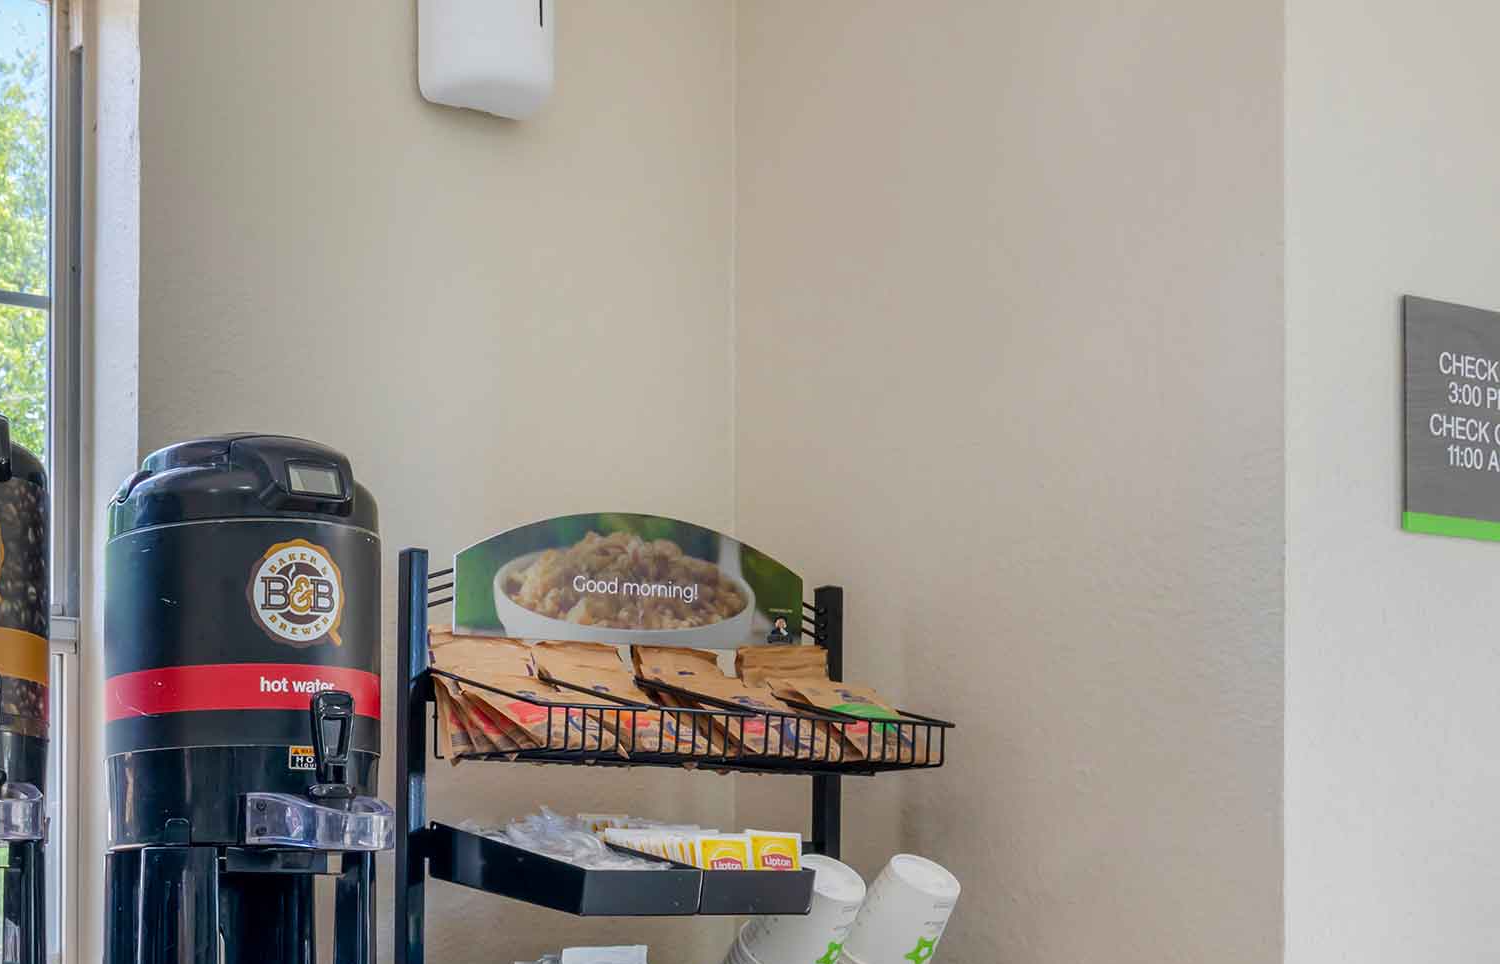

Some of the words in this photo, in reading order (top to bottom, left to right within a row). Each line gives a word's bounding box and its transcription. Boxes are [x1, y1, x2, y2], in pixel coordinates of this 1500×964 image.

[1440, 352, 1499, 382] CHECK
[1448, 382, 1481, 407] 3:00
[1430, 414, 1490, 443] CHECK
[1447, 444, 1483, 469] 11:00
[268, 552, 317, 573] BAKER
[261, 576, 335, 613] B&B
[573, 575, 618, 594] Good
[623, 580, 698, 604] morning!
[260, 676, 289, 693] hot
[292, 678, 336, 694] water
[764, 856, 791, 867] Lipton
